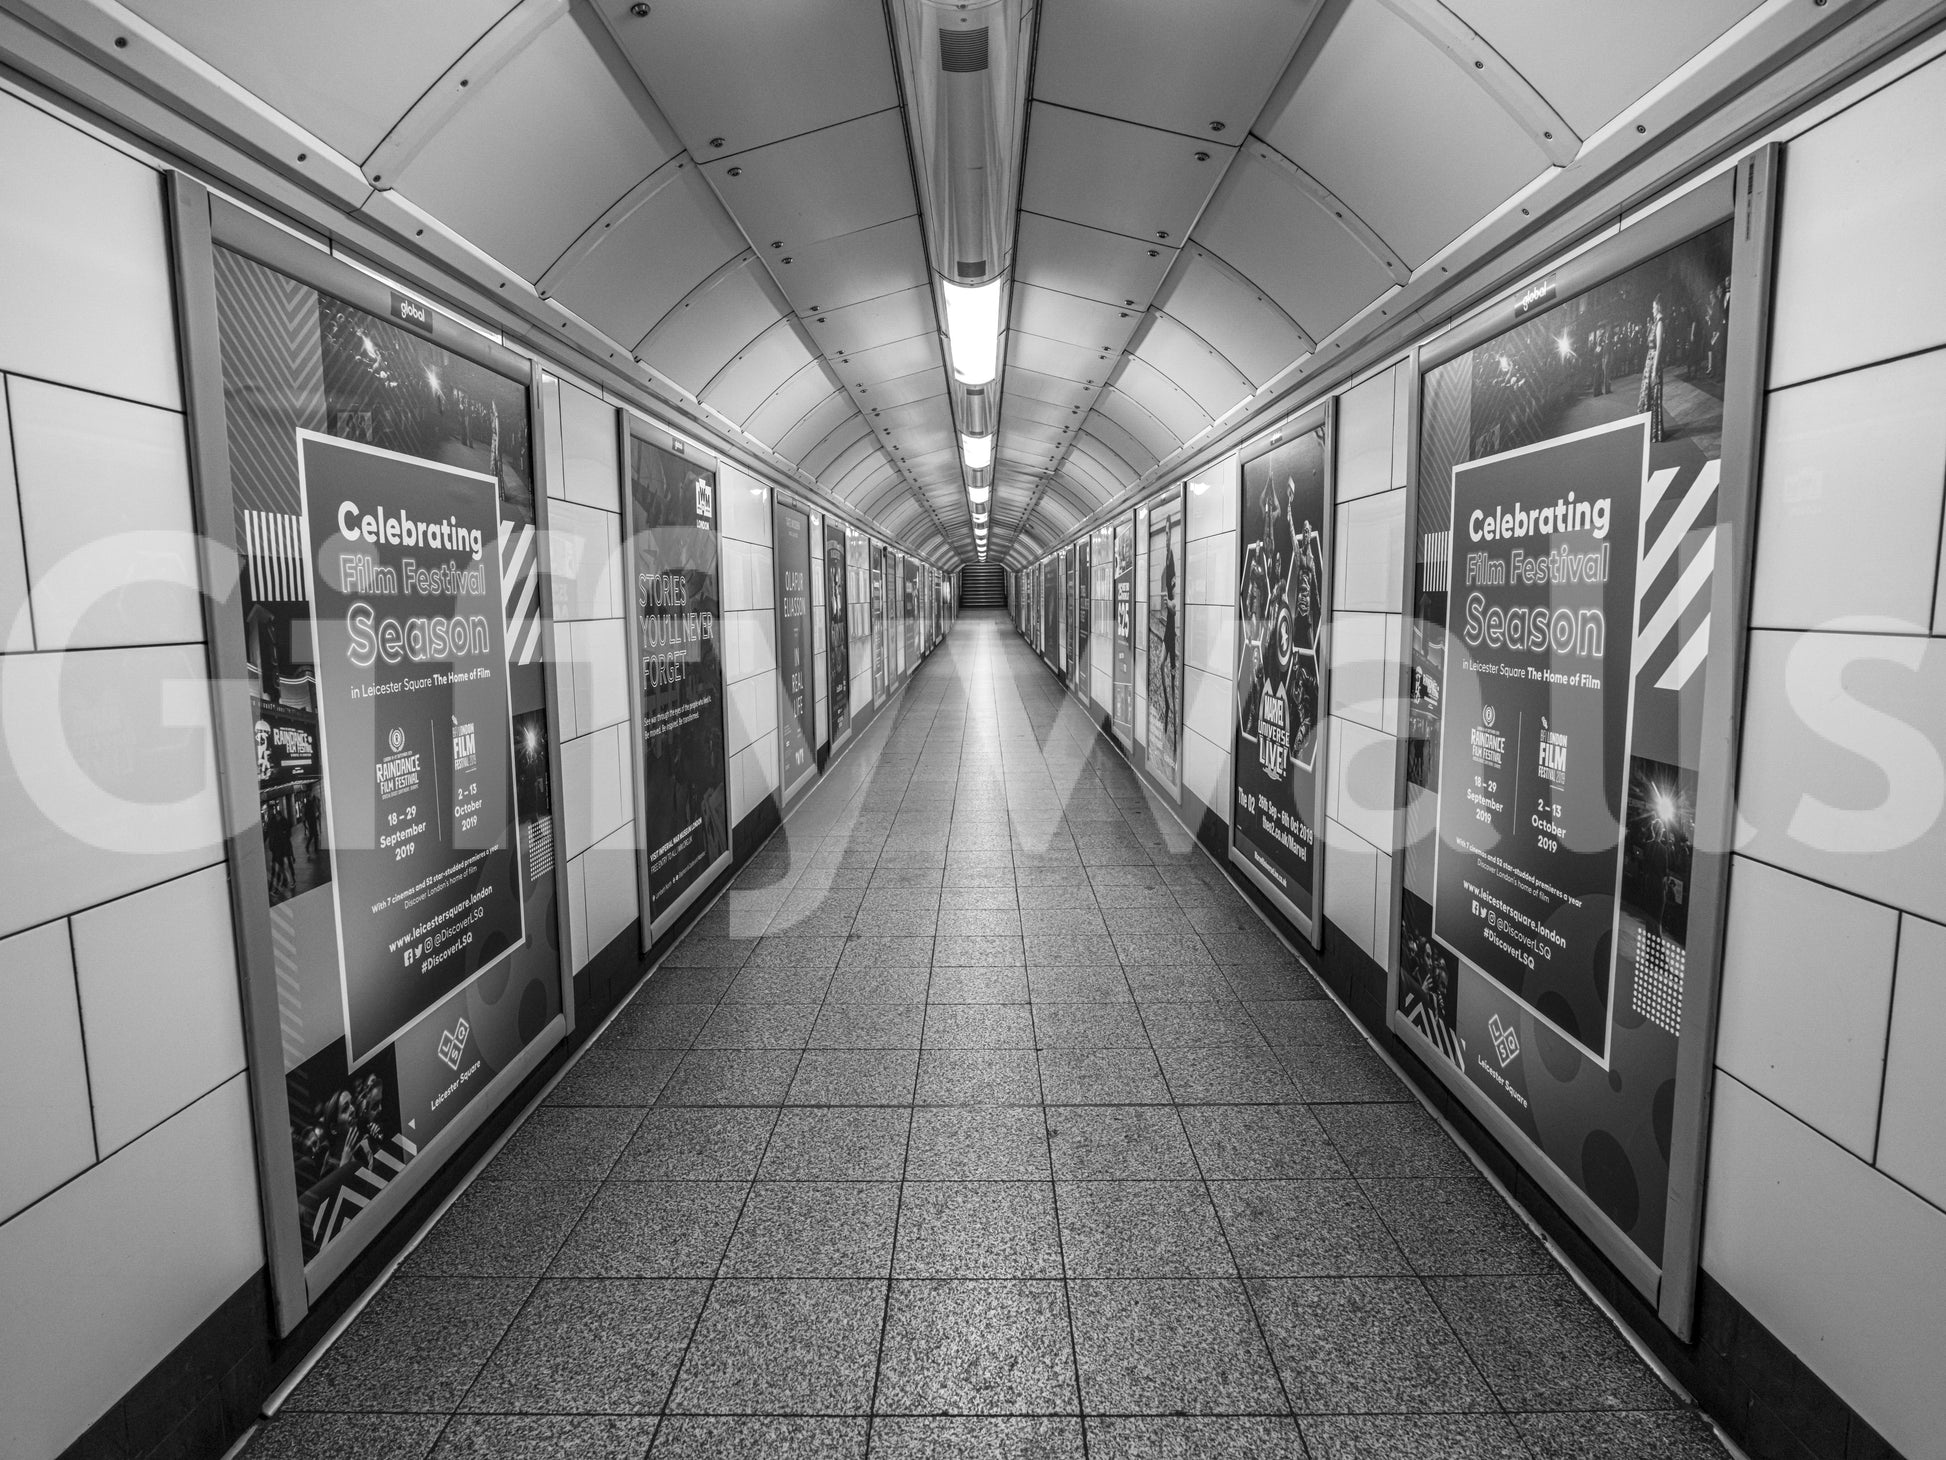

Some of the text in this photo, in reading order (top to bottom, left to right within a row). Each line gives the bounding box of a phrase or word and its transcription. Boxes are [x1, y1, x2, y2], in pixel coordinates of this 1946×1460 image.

[401, 300, 425, 322] global
[1522, 281, 1547, 311] global
[337, 500, 483, 560] Celebrating
[696, 519, 710, 530] LONDON
[1467, 491, 1611, 543] Celebrating
[339, 553, 486, 596] Film Festival
[1466, 543, 1610, 586] Film Festival
[638, 572, 687, 607] STORIES
[346, 601, 490, 667] Season
[639, 611, 714, 648] YOU'LL NEVER
[1463, 592, 1606, 658] Season
[351, 667, 491, 699] in Leicester Square The Home of Film
[642, 649, 687, 690] FORGET
[791, 671, 804, 694] REAL
[1462, 658, 1601, 689] in Leicester Square The Home of Film
[1264, 695, 1284, 727] MARVEL
[453, 733, 475, 759] FILM
[1258, 719, 1290, 747] UNIVERSE
[1471, 728, 1505, 753] RAINDANCE
[1547, 731, 1568, 747] LONDON
[376, 754, 420, 783] RAINDANCE
[1259, 735, 1288, 777] LIVE!
[1472, 745, 1483, 760] FILM
[1483, 748, 1502, 764] FESTIVAL
[1539, 741, 1567, 771] FILM
[380, 780, 394, 794] FILM
[395, 772, 419, 791] FESTIVAL
[1474, 775, 1481, 787] 18
[1488, 780, 1497, 793] 29
[1538, 765, 1555, 782] FESTIVAL
[458, 788, 464, 800] 2
[469, 783, 477, 795] 13
[1238, 785, 1247, 808] The
[1467, 788, 1504, 813] September
[388, 812, 398, 826] 18
[406, 805, 417, 820] 29
[454, 799, 482, 817] October
[461, 815, 477, 831] 2019
[1269, 800, 1277, 821] Sep
[1281, 810, 1289, 828] 6th
[1290, 816, 1299, 835] Oct
[1300, 824, 1313, 845] 2019
[1476, 808, 1491, 824] 2019
[1538, 799, 1543, 811] 2
[1552, 804, 1562, 818] 13
[380, 822, 426, 848] September
[1531, 814, 1567, 838] October
[395, 842, 415, 861] 2019
[650, 850, 659, 862] VISIT
[1537, 835, 1558, 853] 2019
[371, 900, 387, 914] With
[387, 897, 391, 906] 7
[392, 888, 415, 904] cinemas
[415, 879, 426, 892] and
[426, 876, 433, 887] 52
[433, 862, 464, 883] star-studded
[464, 852, 486, 870] premieres
[489, 844, 499, 855] year
[404, 865, 477, 910] Discover London's home of film
[1469, 843, 1487, 859] cinemas
[1487, 853, 1496, 864] and
[1496, 857, 1502, 867] 52
[1502, 862, 1535, 884] star-studded
[1535, 877, 1563, 898] premieres
[1567, 896, 1583, 908] year
[1477, 858, 1550, 903] Discover London's home of film
[388, 885, 493, 953] www.leicestersquare.london
[434, 906, 484, 947] @DiscoverLSQ
[1463, 880, 1566, 948] www.leicestersquare.london
[421, 931, 473, 974] #DiscoverLSQ
[1483, 927, 1535, 970] #DiscoverLSQ
[1496, 917, 1551, 960] @DiscoverLSQ
[431, 1060, 481, 1111] Leicester Square
[1478, 1054, 1528, 1108] Leicester Square
